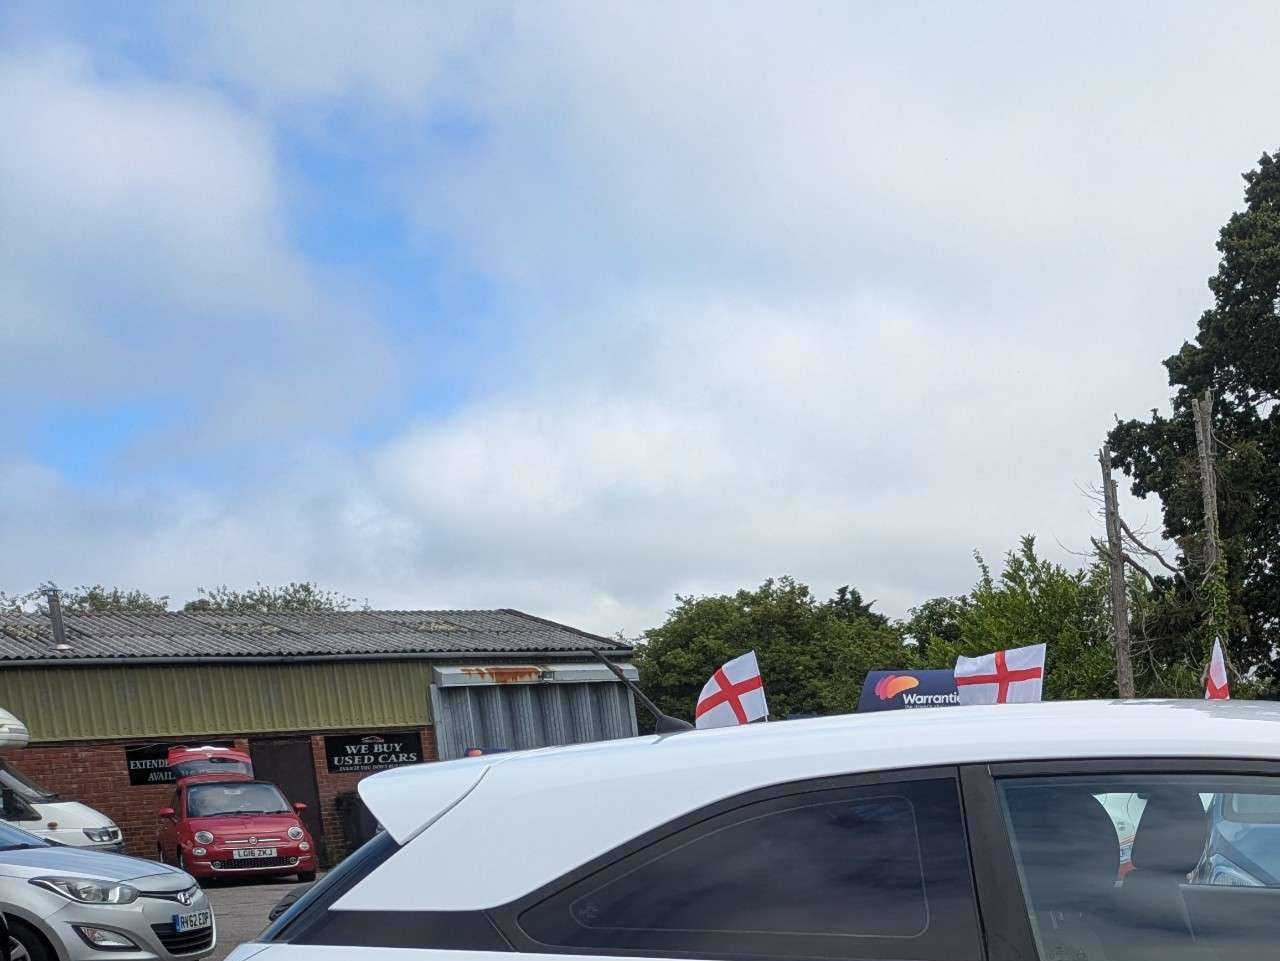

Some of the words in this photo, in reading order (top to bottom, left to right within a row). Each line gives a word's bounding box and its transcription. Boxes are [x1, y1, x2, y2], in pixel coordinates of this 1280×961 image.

[344, 744, 369, 755] WE
[373, 742, 403, 754] BUY
[333, 754, 375, 766] USED
[378, 752, 417, 763] CARS
